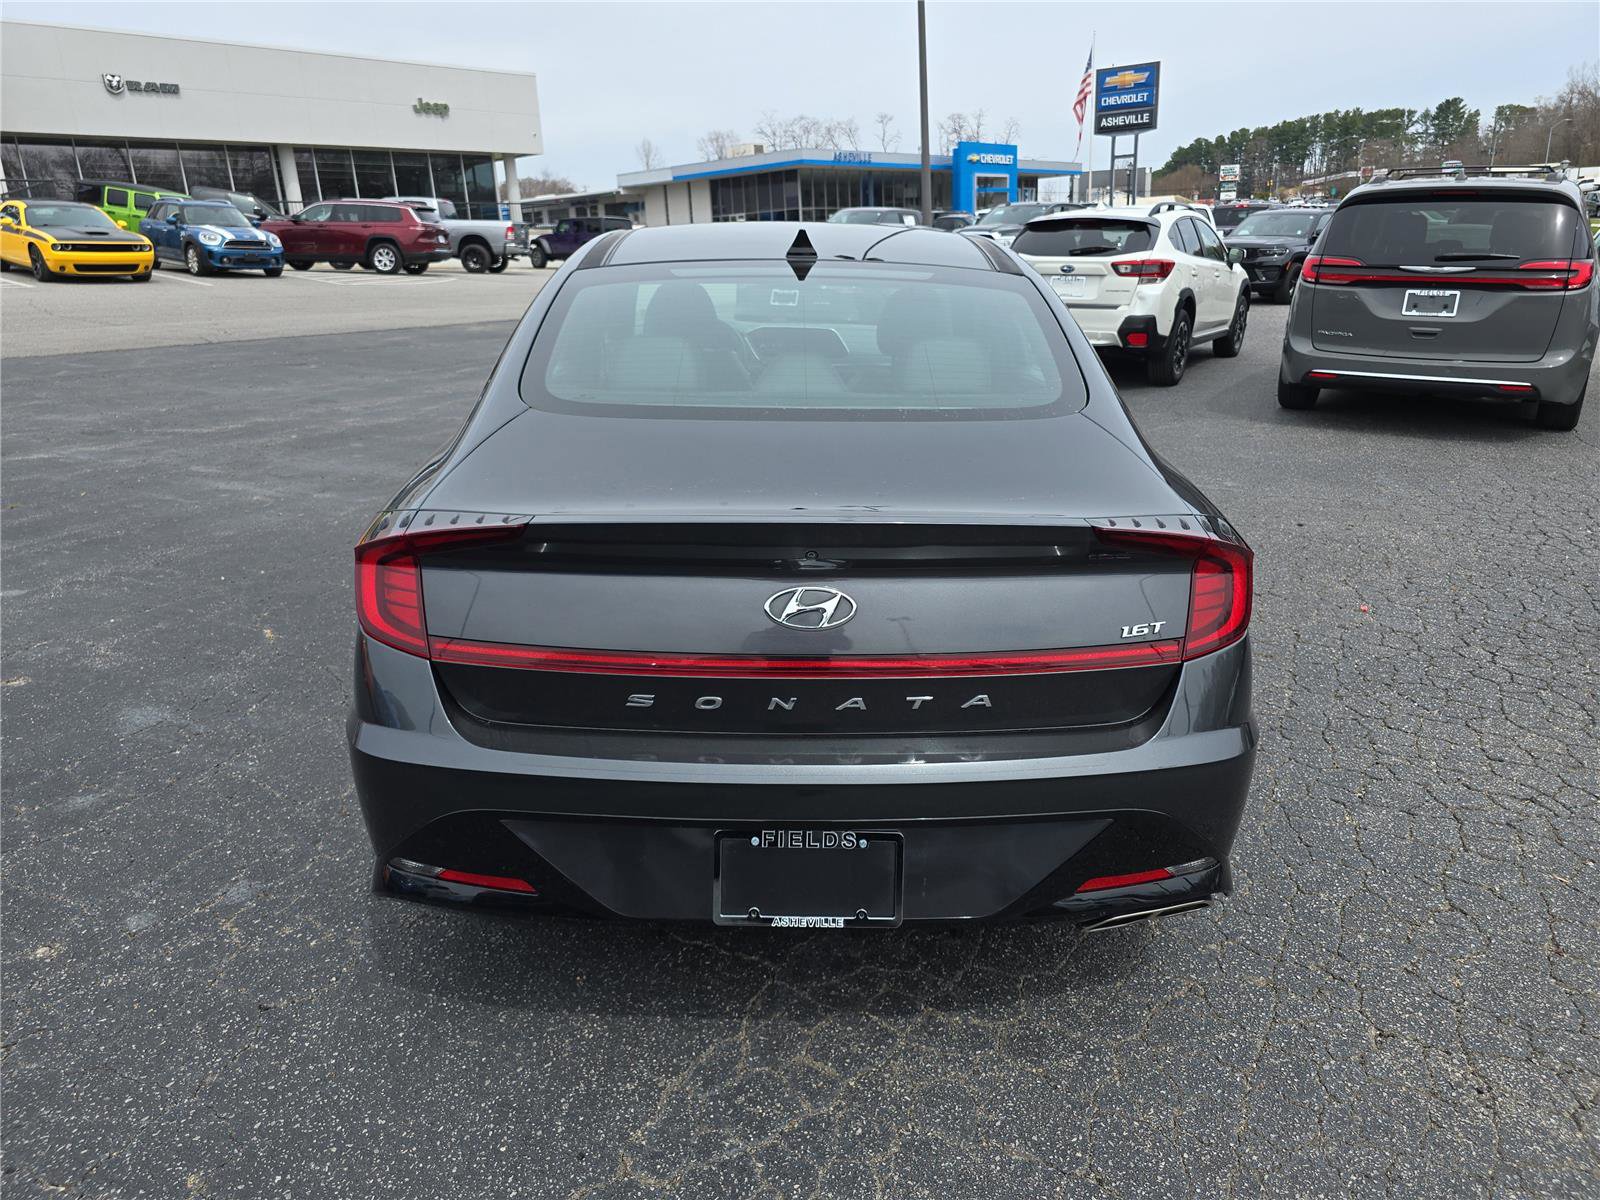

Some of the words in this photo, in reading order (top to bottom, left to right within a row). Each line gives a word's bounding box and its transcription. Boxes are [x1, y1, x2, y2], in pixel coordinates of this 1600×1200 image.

[126, 80, 180, 95] RAM
[1101, 92, 1149, 106] CHEVROLET
[412, 97, 450, 119] Jeep
[1101, 113, 1150, 127] ASHEVILLE
[980, 153, 1014, 165] CHEVROLET
[625, 694, 993, 711] SONATA
[761, 830, 858, 849] FIELDS
[771, 917, 845, 928] ASHEVILLE
